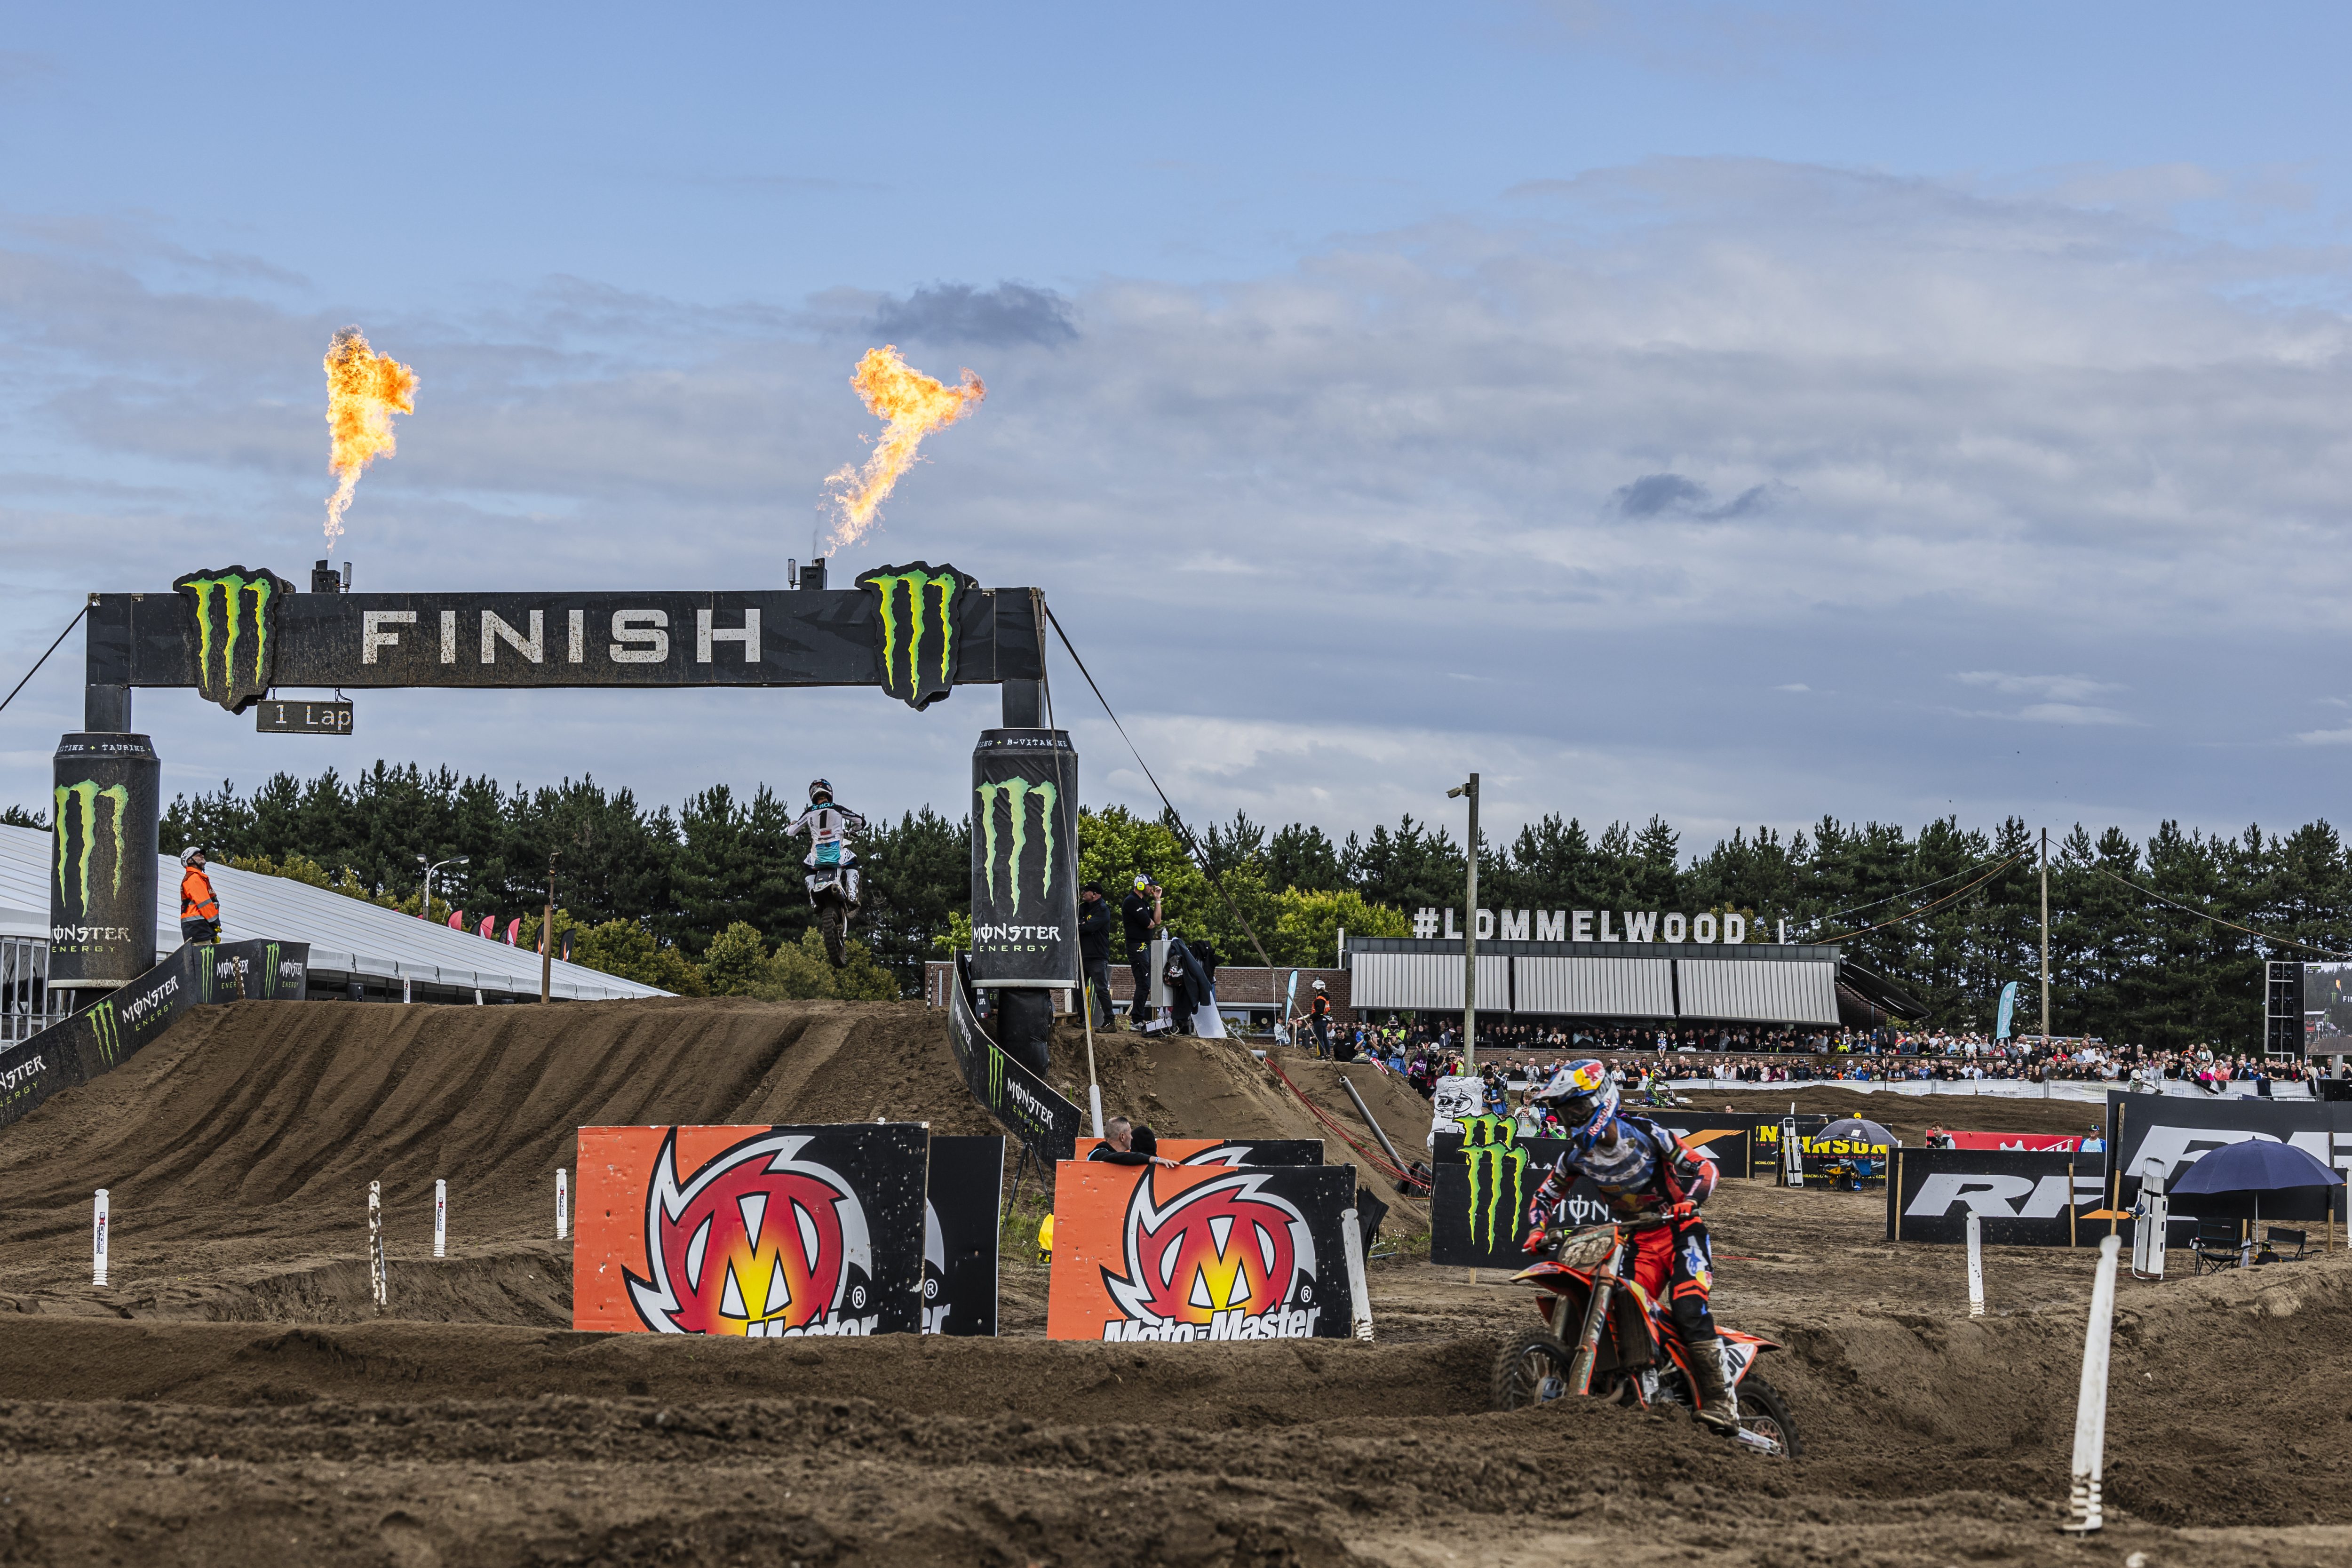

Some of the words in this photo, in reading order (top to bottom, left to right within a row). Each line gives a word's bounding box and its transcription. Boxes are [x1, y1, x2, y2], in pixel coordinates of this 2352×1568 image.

[363, 609, 760, 664] FINISH
[276, 705, 287, 724] 1
[306, 706, 350, 730] Lap
[818, 810, 828, 829] 1
[974, 923, 1061, 942] MONSTER
[1413, 907, 1745, 944] #LOMMELWOOD
[280, 959, 302, 978] MONSTER
[122, 975, 179, 1023] MONSTER
[135, 999, 174, 1031] ENERGY
[1008, 1077, 1053, 1130] MONSTER
